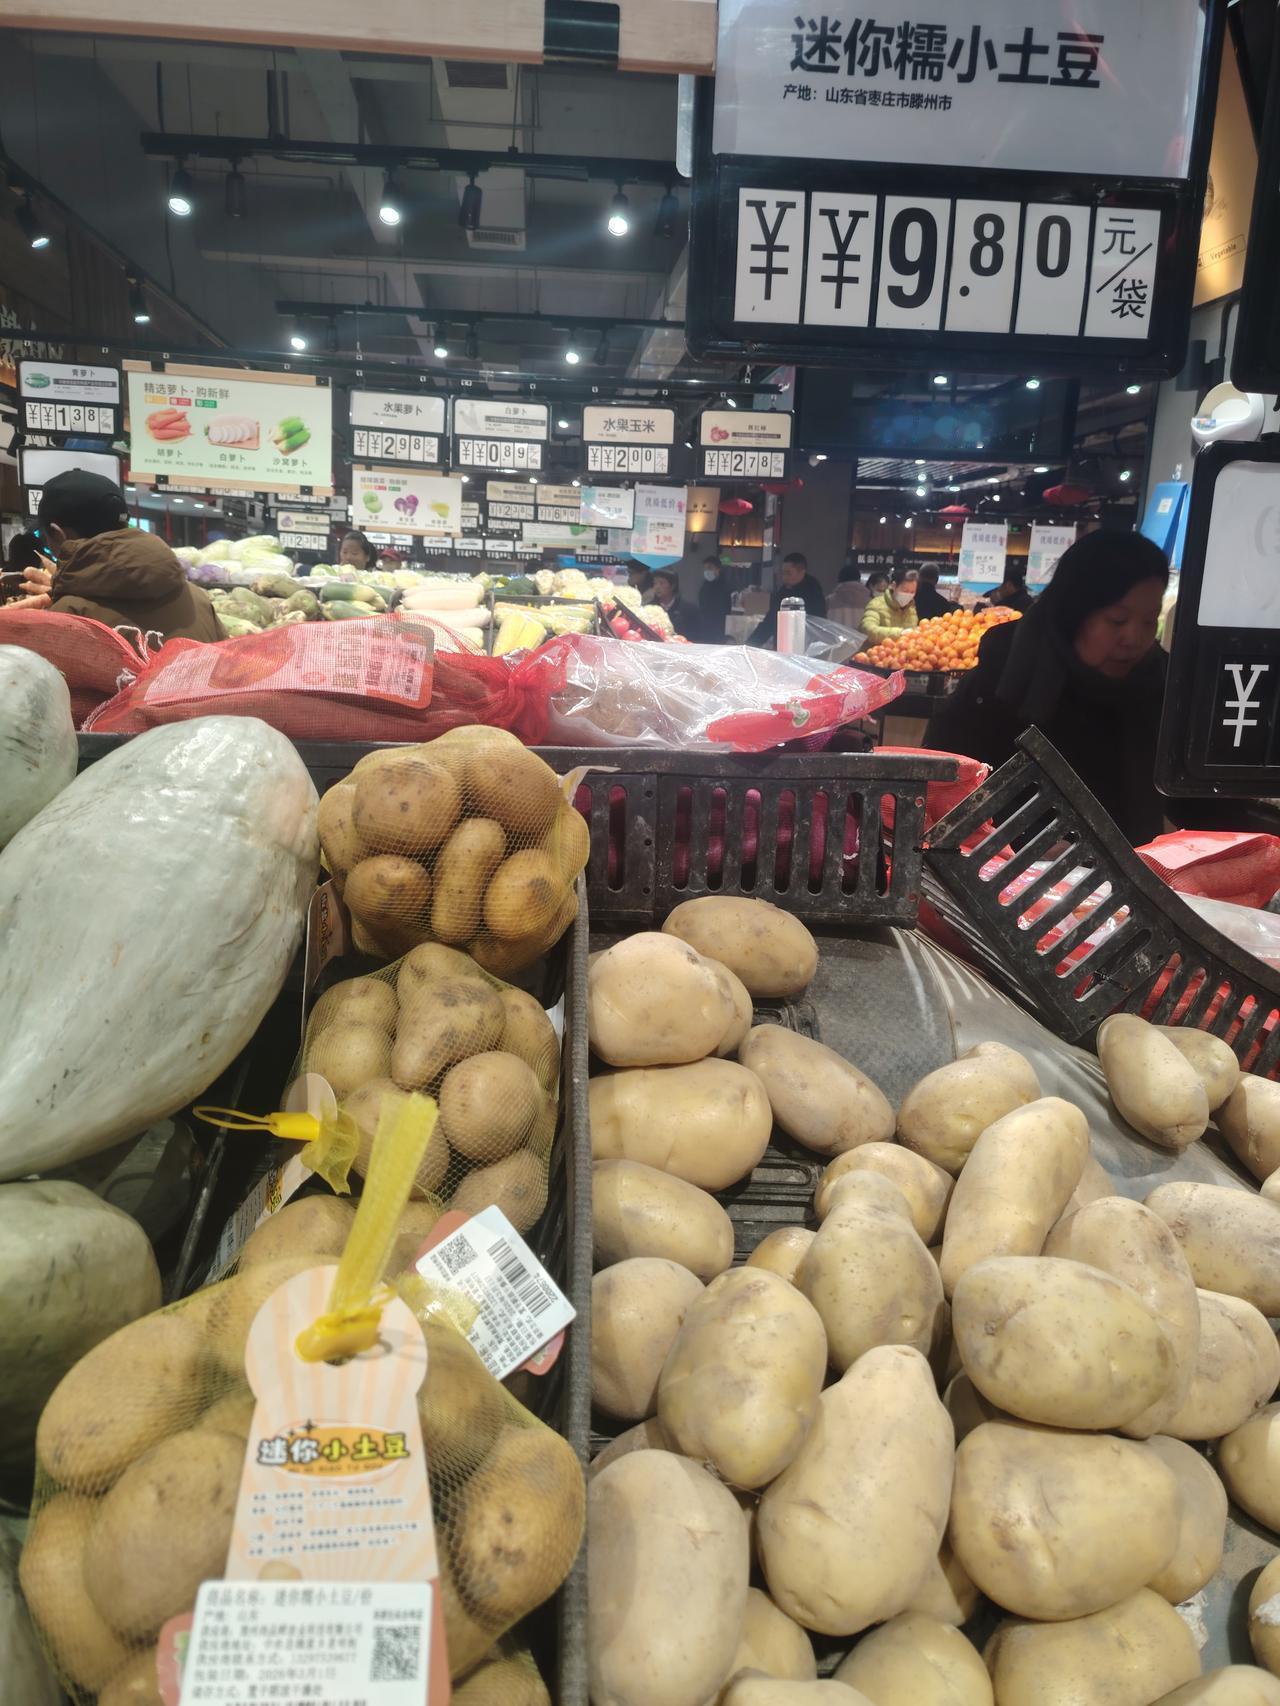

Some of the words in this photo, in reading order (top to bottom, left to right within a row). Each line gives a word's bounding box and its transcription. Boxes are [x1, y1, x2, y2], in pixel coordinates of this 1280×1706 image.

[790, 14, 1105, 89] 迷你糯小土豆
[603, 418, 655, 433] 水果玉米
[1222, 663, 1270, 747] ¥
[256, 1433, 411, 1466] 迷你小土豆
